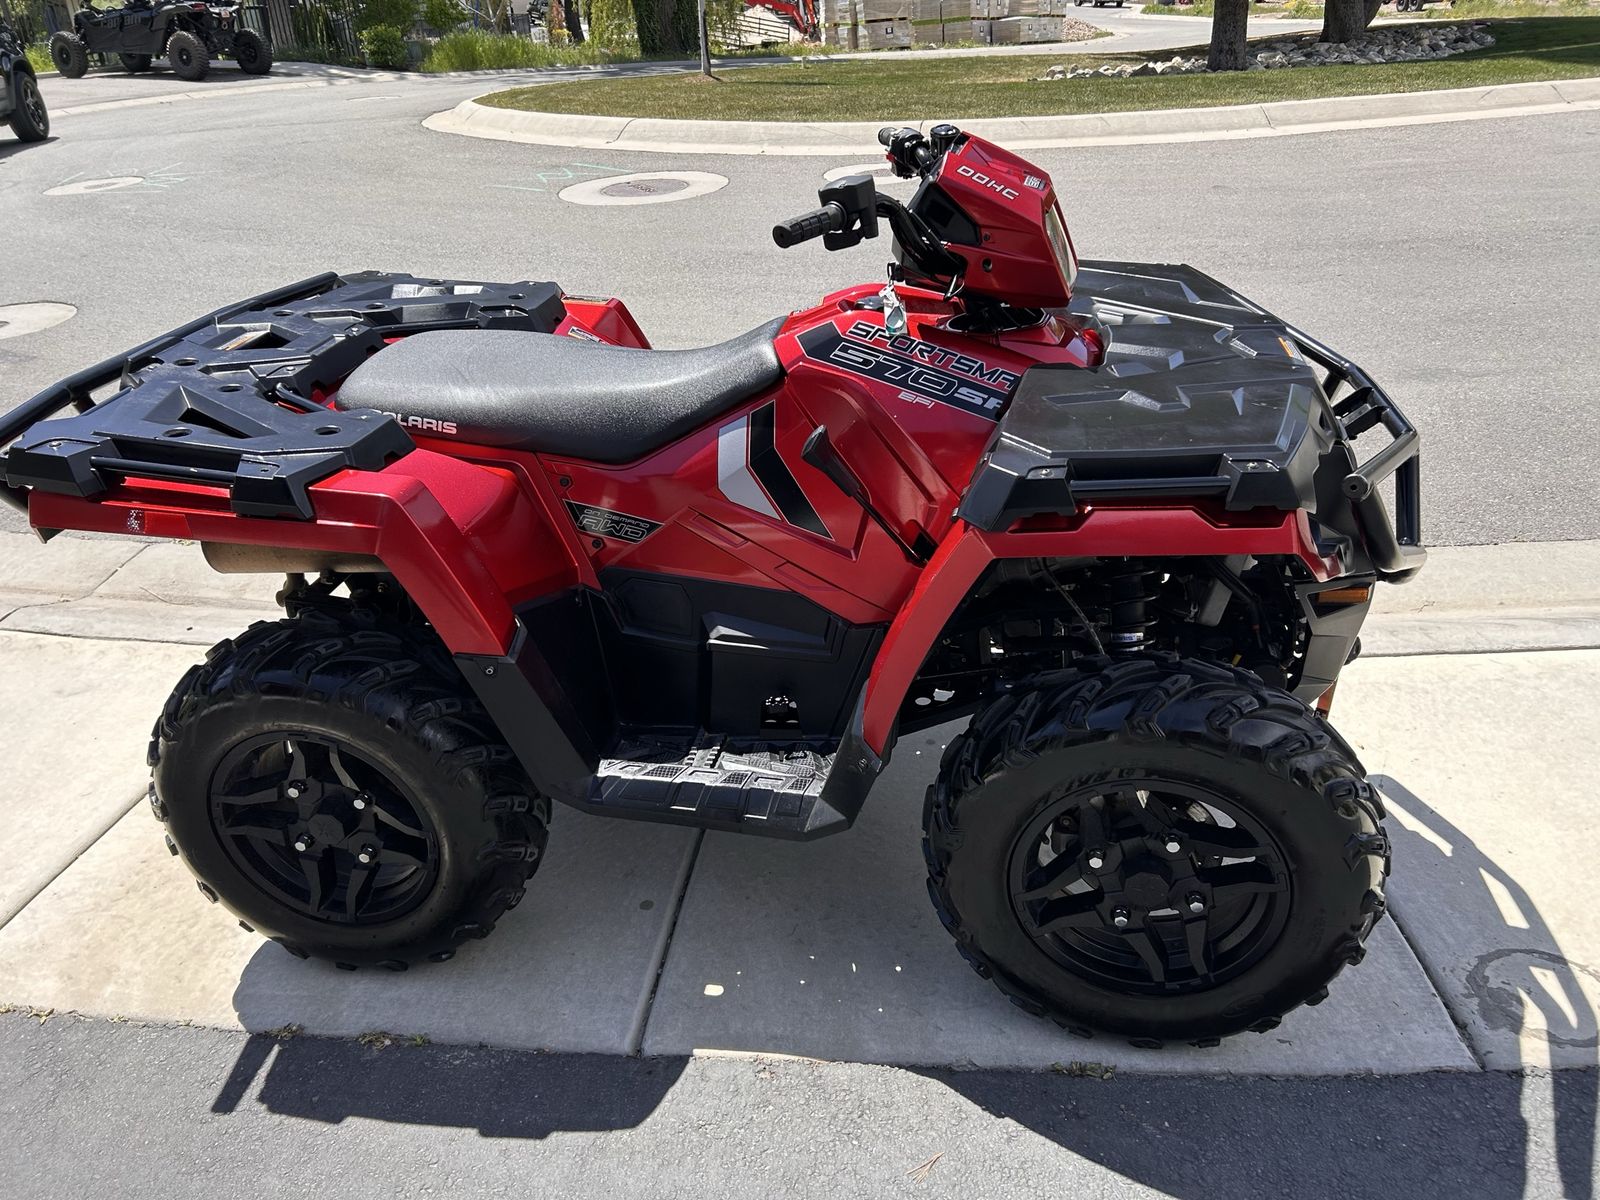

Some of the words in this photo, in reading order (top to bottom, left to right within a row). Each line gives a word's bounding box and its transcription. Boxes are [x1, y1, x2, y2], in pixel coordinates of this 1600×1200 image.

[956, 164, 1020, 200] DOHC
[829, 341, 958, 397] 570
[897, 391, 934, 409] EFI
[369, 408, 457, 434] LARIS
[576, 514, 648, 541] AWD
[604, 513, 650, 529] DEMAND
